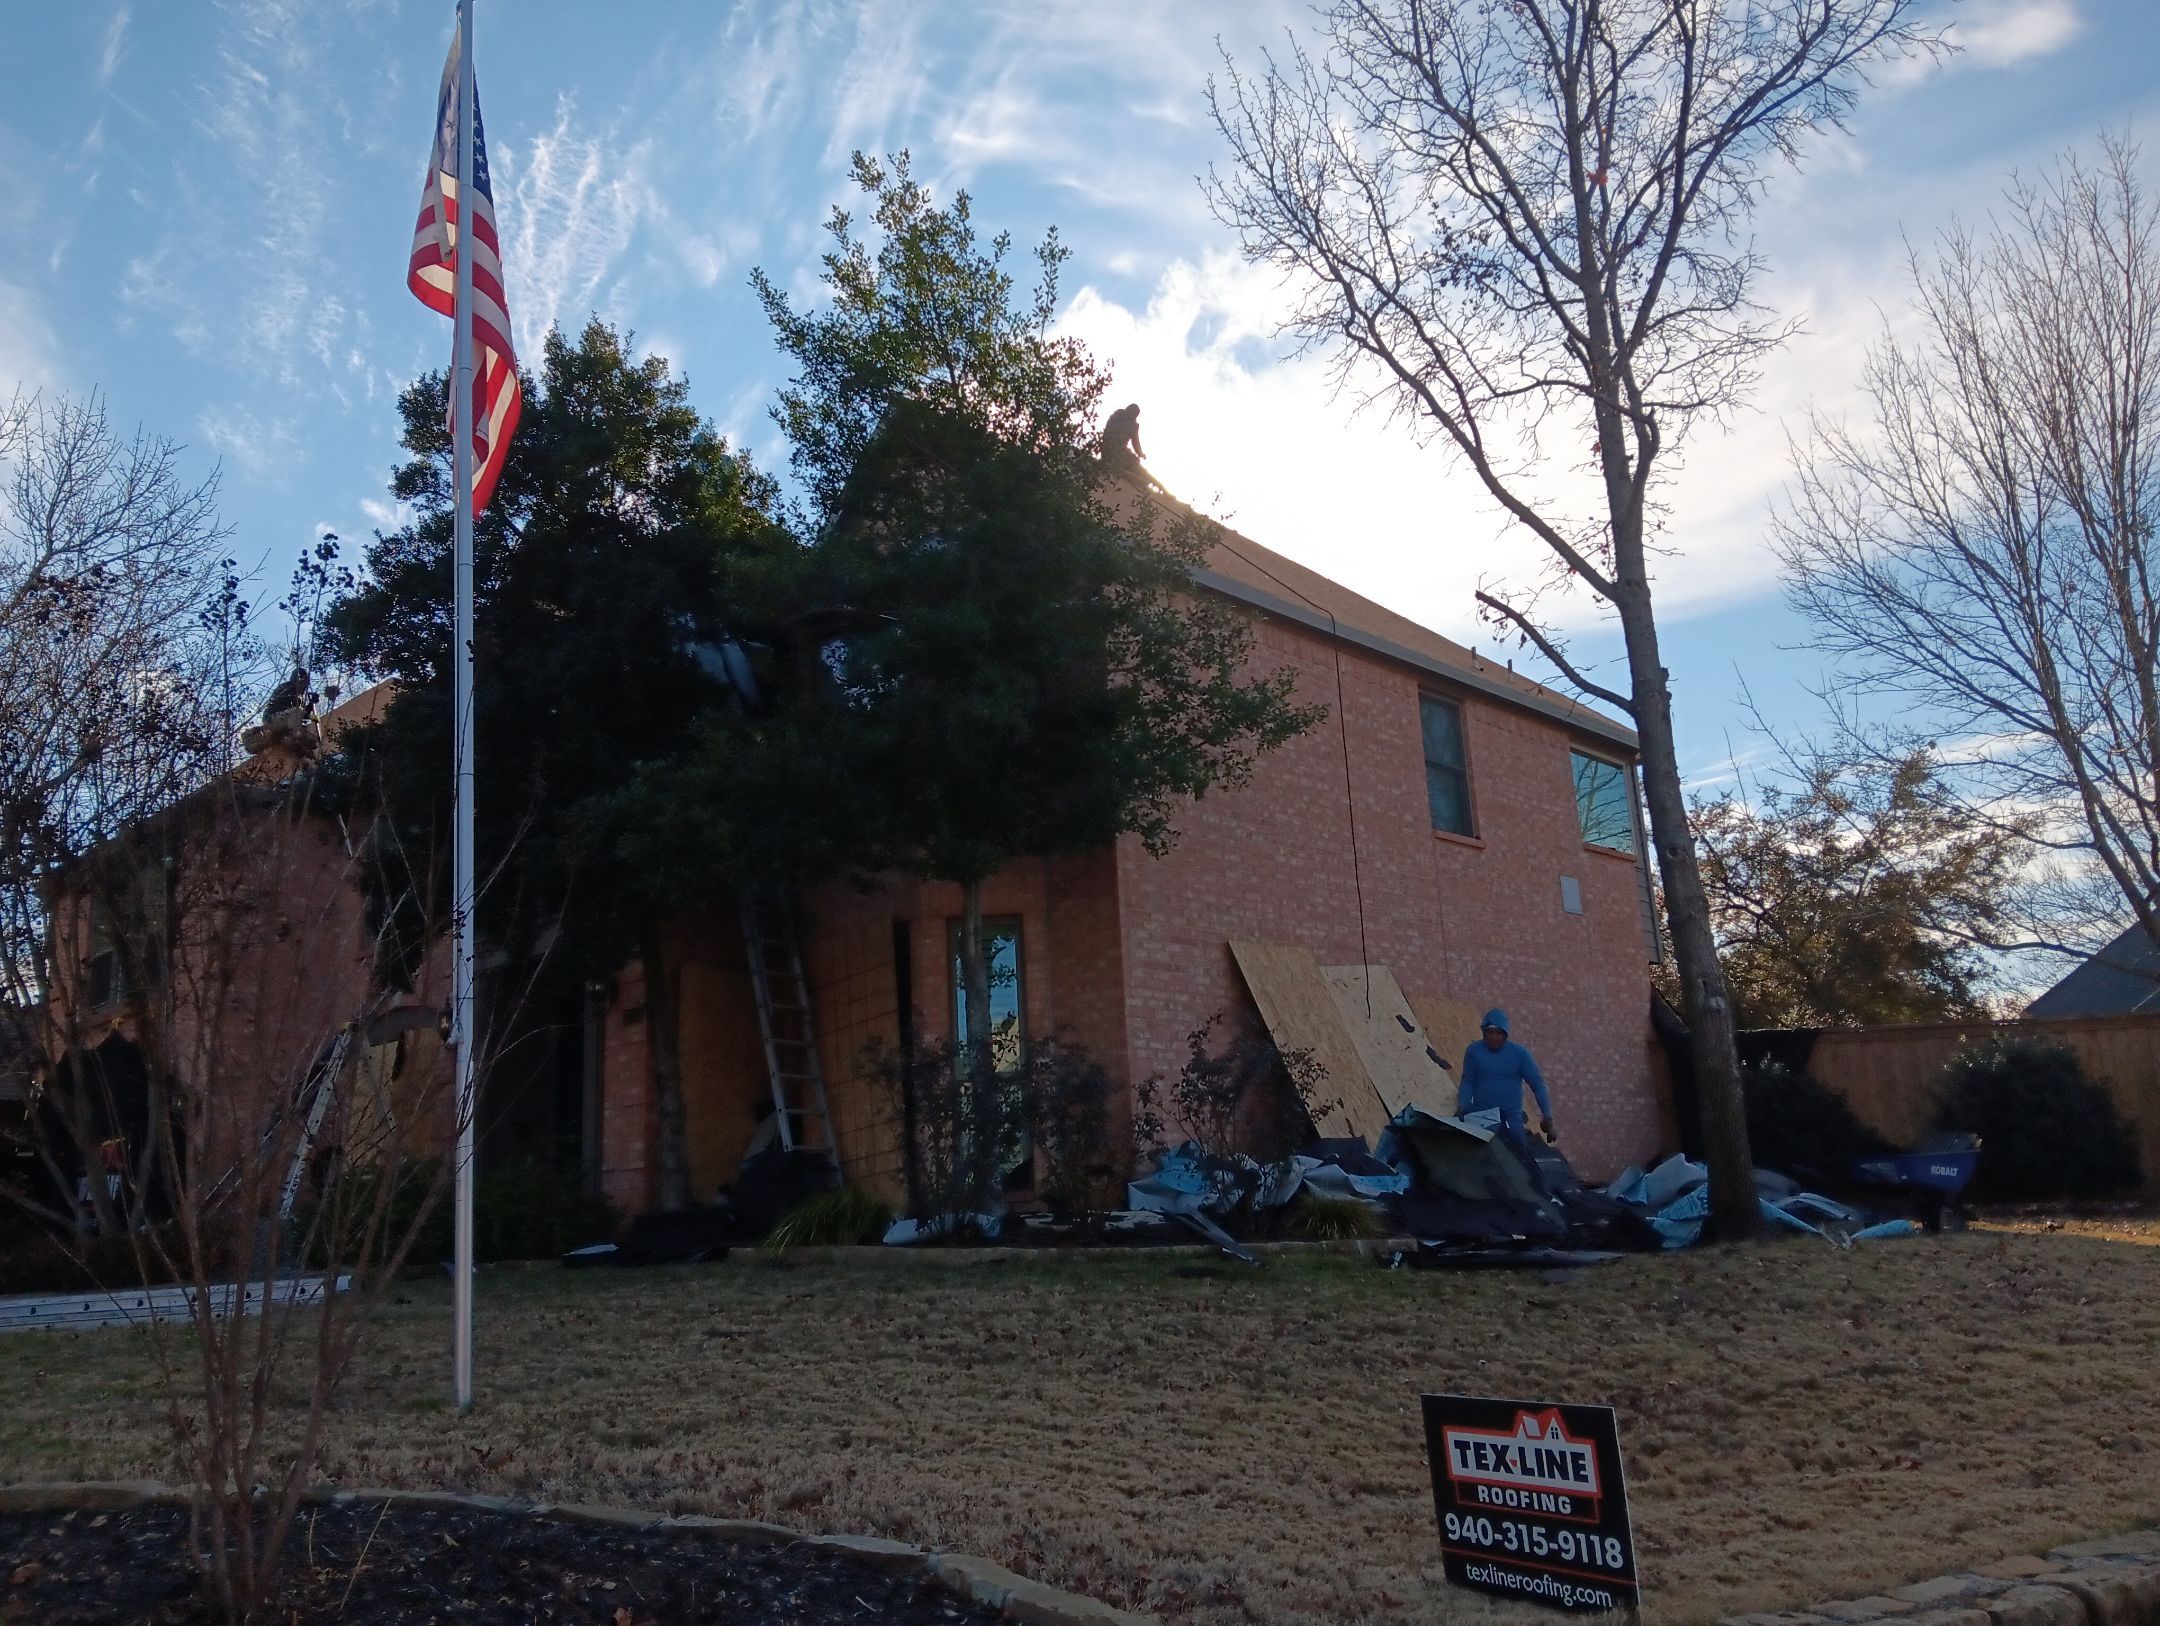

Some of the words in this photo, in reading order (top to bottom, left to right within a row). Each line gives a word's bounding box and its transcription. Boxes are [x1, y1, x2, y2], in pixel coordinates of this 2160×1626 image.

[1477, 1485, 1572, 1515] ROOFING
[1445, 1512, 1624, 1569] 940-315-9118
[1466, 1562, 1613, 1607] texlineroofing.com
